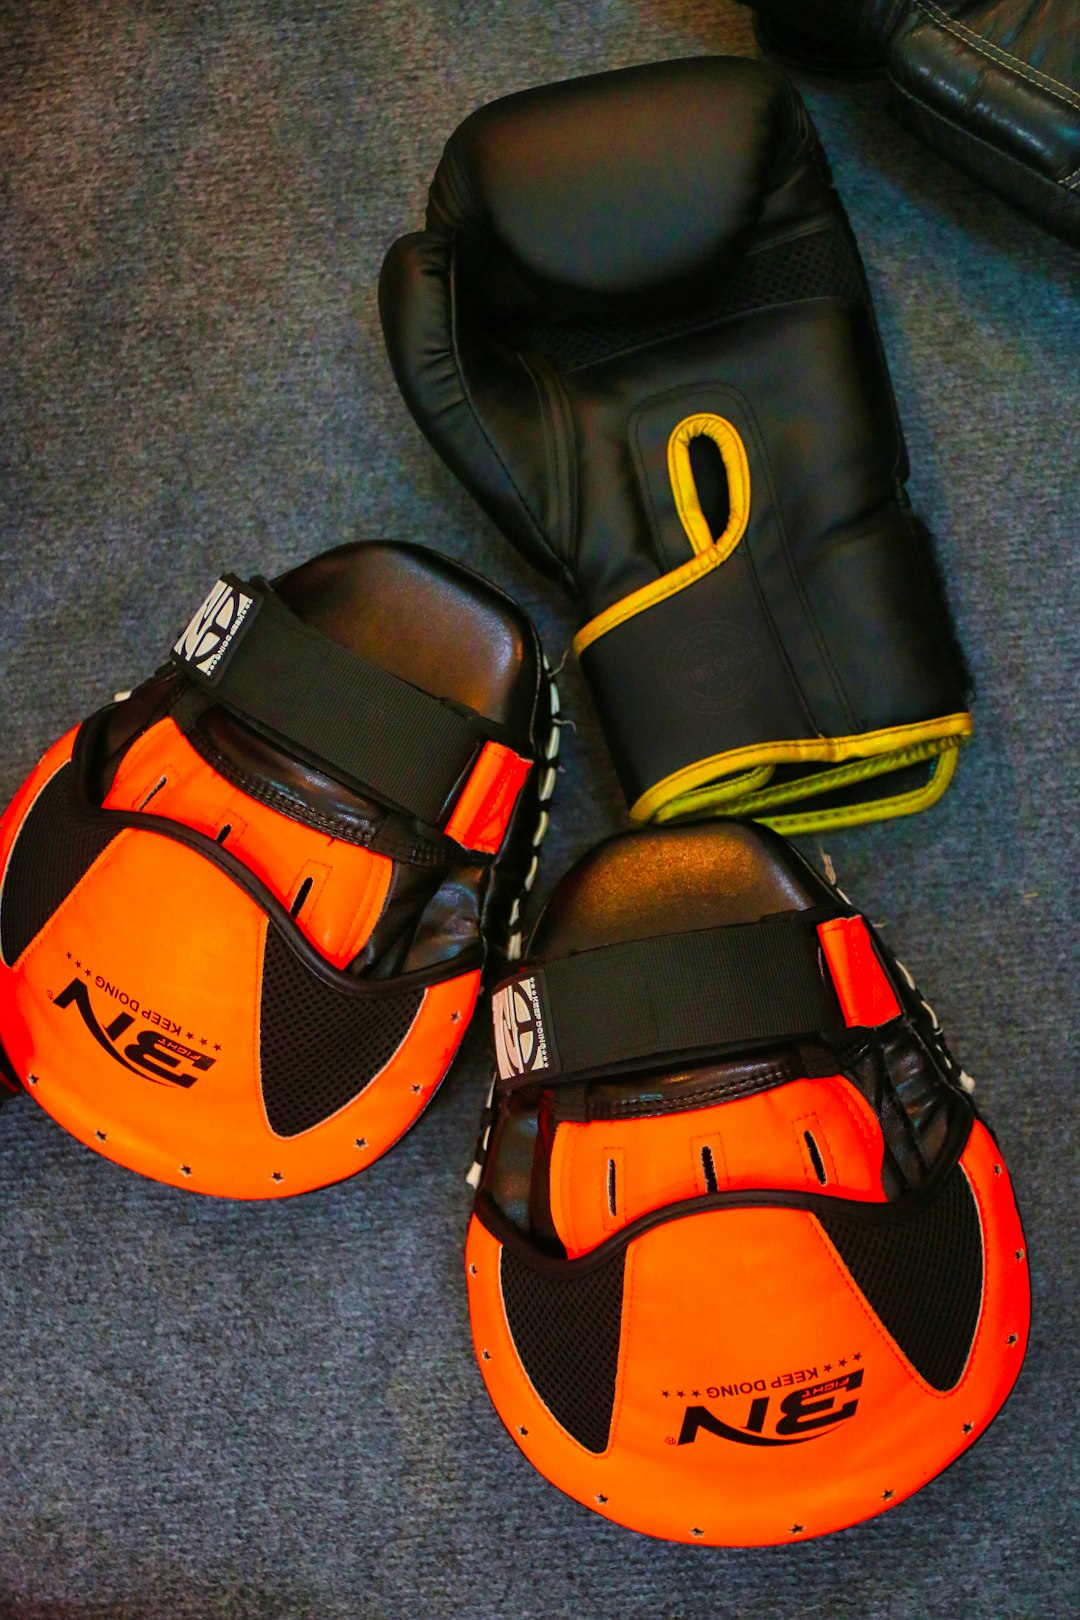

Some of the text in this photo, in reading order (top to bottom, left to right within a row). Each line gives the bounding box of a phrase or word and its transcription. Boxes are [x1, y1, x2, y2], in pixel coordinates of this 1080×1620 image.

[215, 615, 245, 661] KEEP DOING
[95, 975, 182, 1036] KEEP DOING
[532, 996, 547, 1049] KEEP DOING
[157, 1037, 201, 1061] FIGHT
[706, 1367, 819, 1399] KEEP DOING
[801, 1376, 850, 1398] FIGHT
